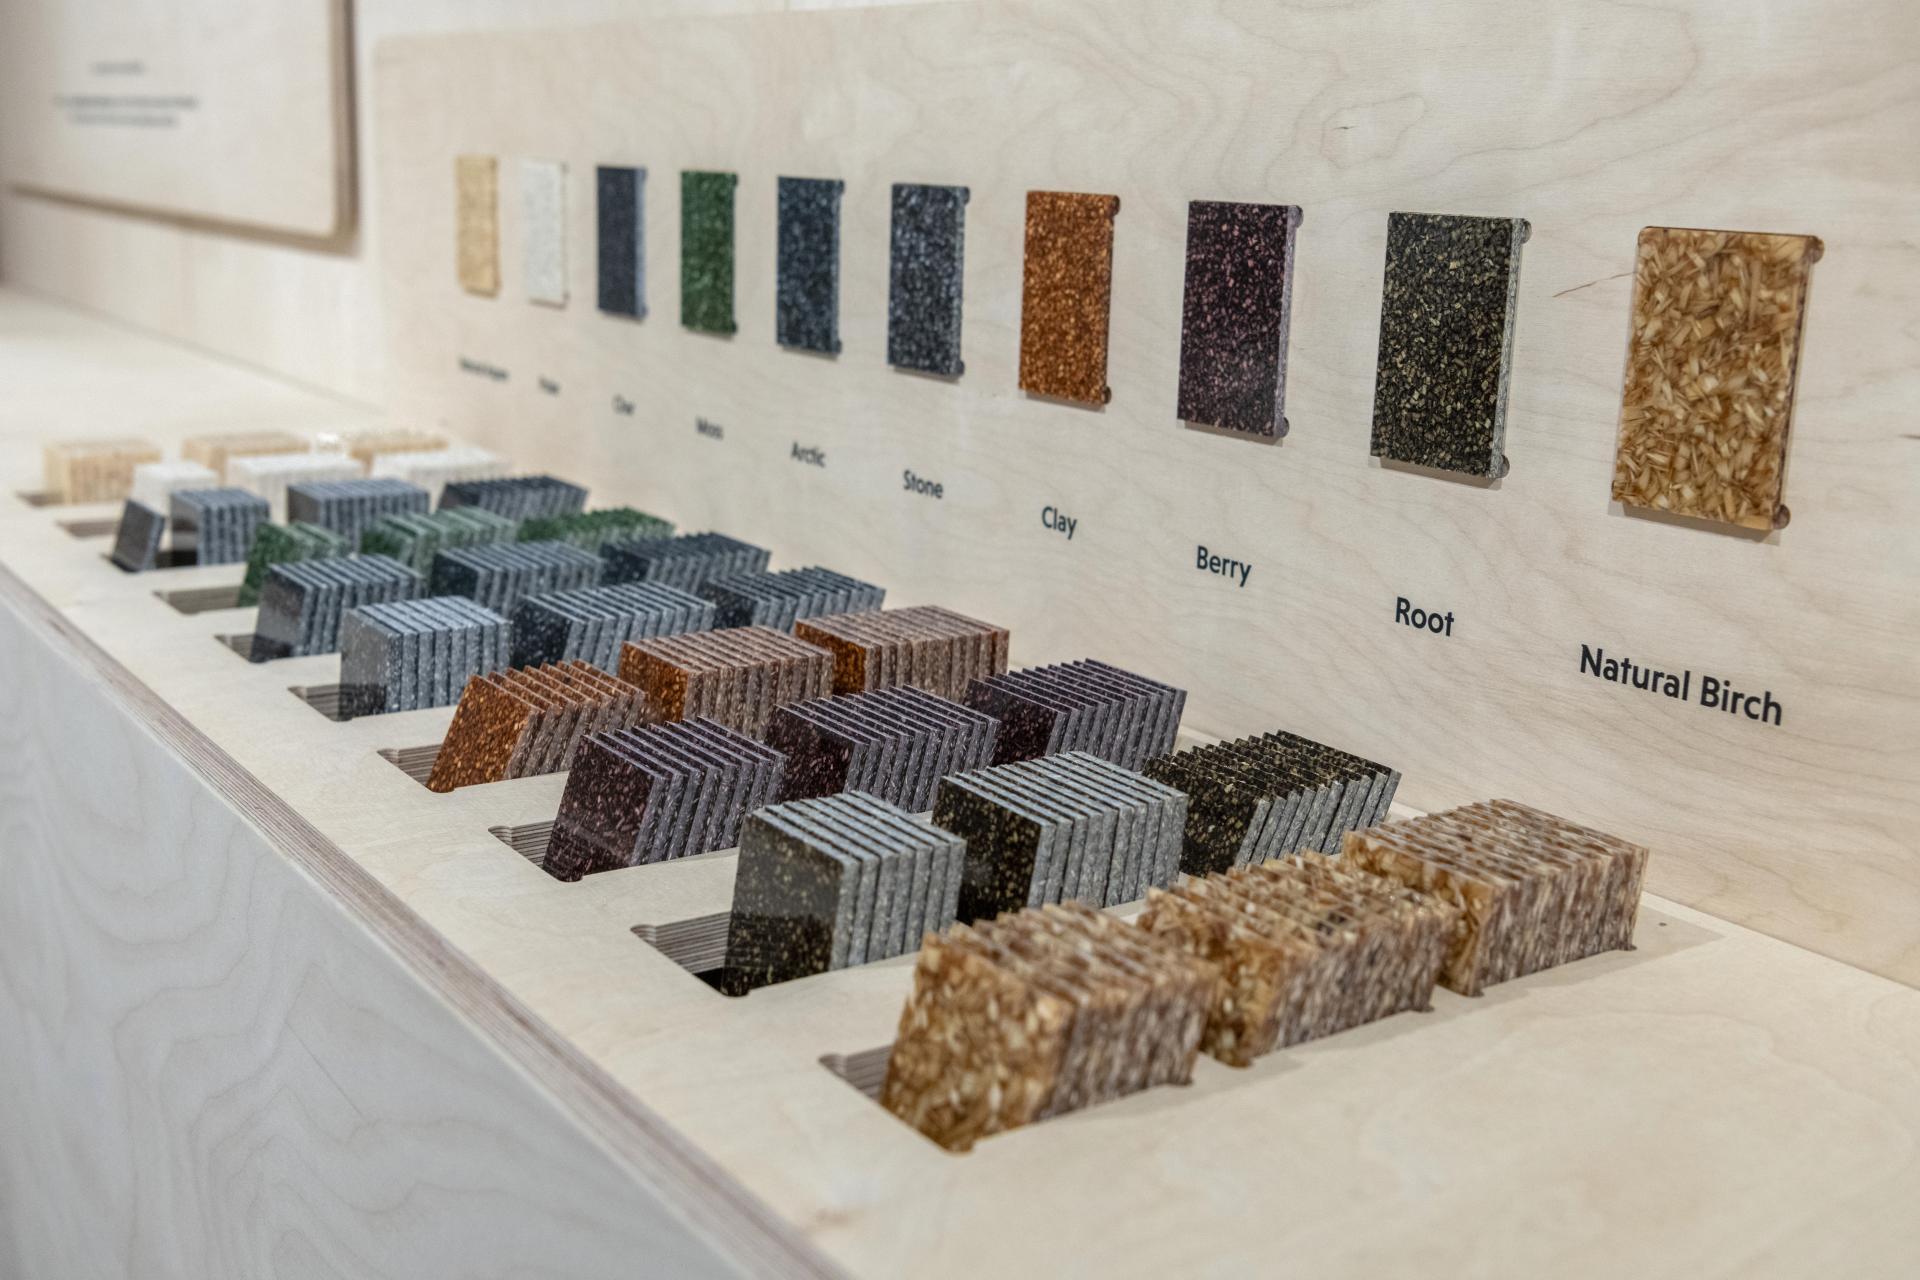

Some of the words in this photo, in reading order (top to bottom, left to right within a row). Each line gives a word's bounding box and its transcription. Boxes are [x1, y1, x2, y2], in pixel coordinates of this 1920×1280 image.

[790, 441, 825, 468] Arctic
[903, 469, 944, 500] Stone
[1041, 506, 1078, 541] Clay
[1196, 545, 1252, 588] Berry
[1395, 596, 1455, 637] Root
[1580, 643, 1691, 702] Natural
[1699, 675, 1783, 727] Birch
